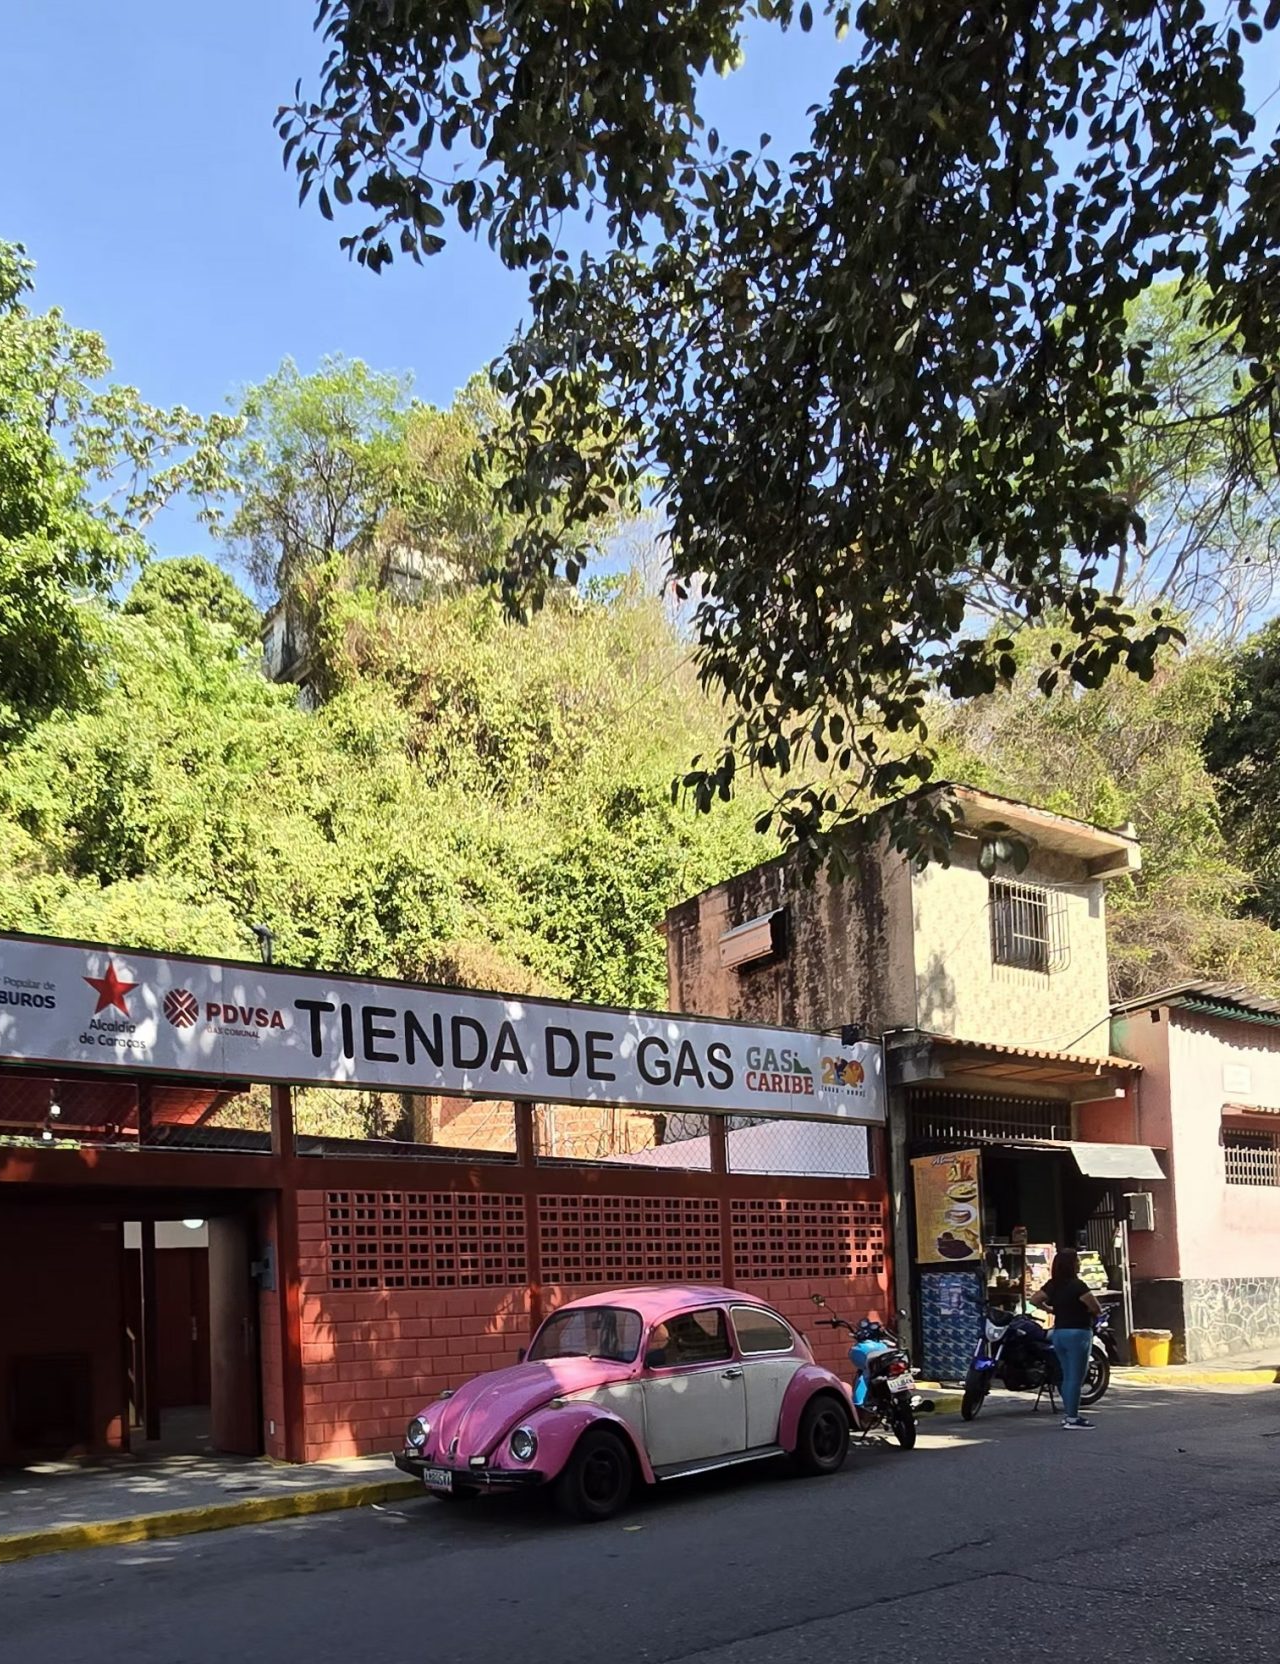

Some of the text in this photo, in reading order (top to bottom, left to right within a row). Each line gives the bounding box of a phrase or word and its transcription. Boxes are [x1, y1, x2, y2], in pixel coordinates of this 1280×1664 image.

[3, 976, 42, 989] Popular
[43, 981, 56, 991] de
[206, 1002, 286, 1030] PDVSA
[79, 1031, 147, 1049] de Caracas
[207, 1025, 261, 1039] GAS COMUNAL
[294, 999, 734, 1090] TIENDA DE GAS
[746, 1046, 794, 1073] GAS
[745, 1071, 815, 1096] CARIBE
